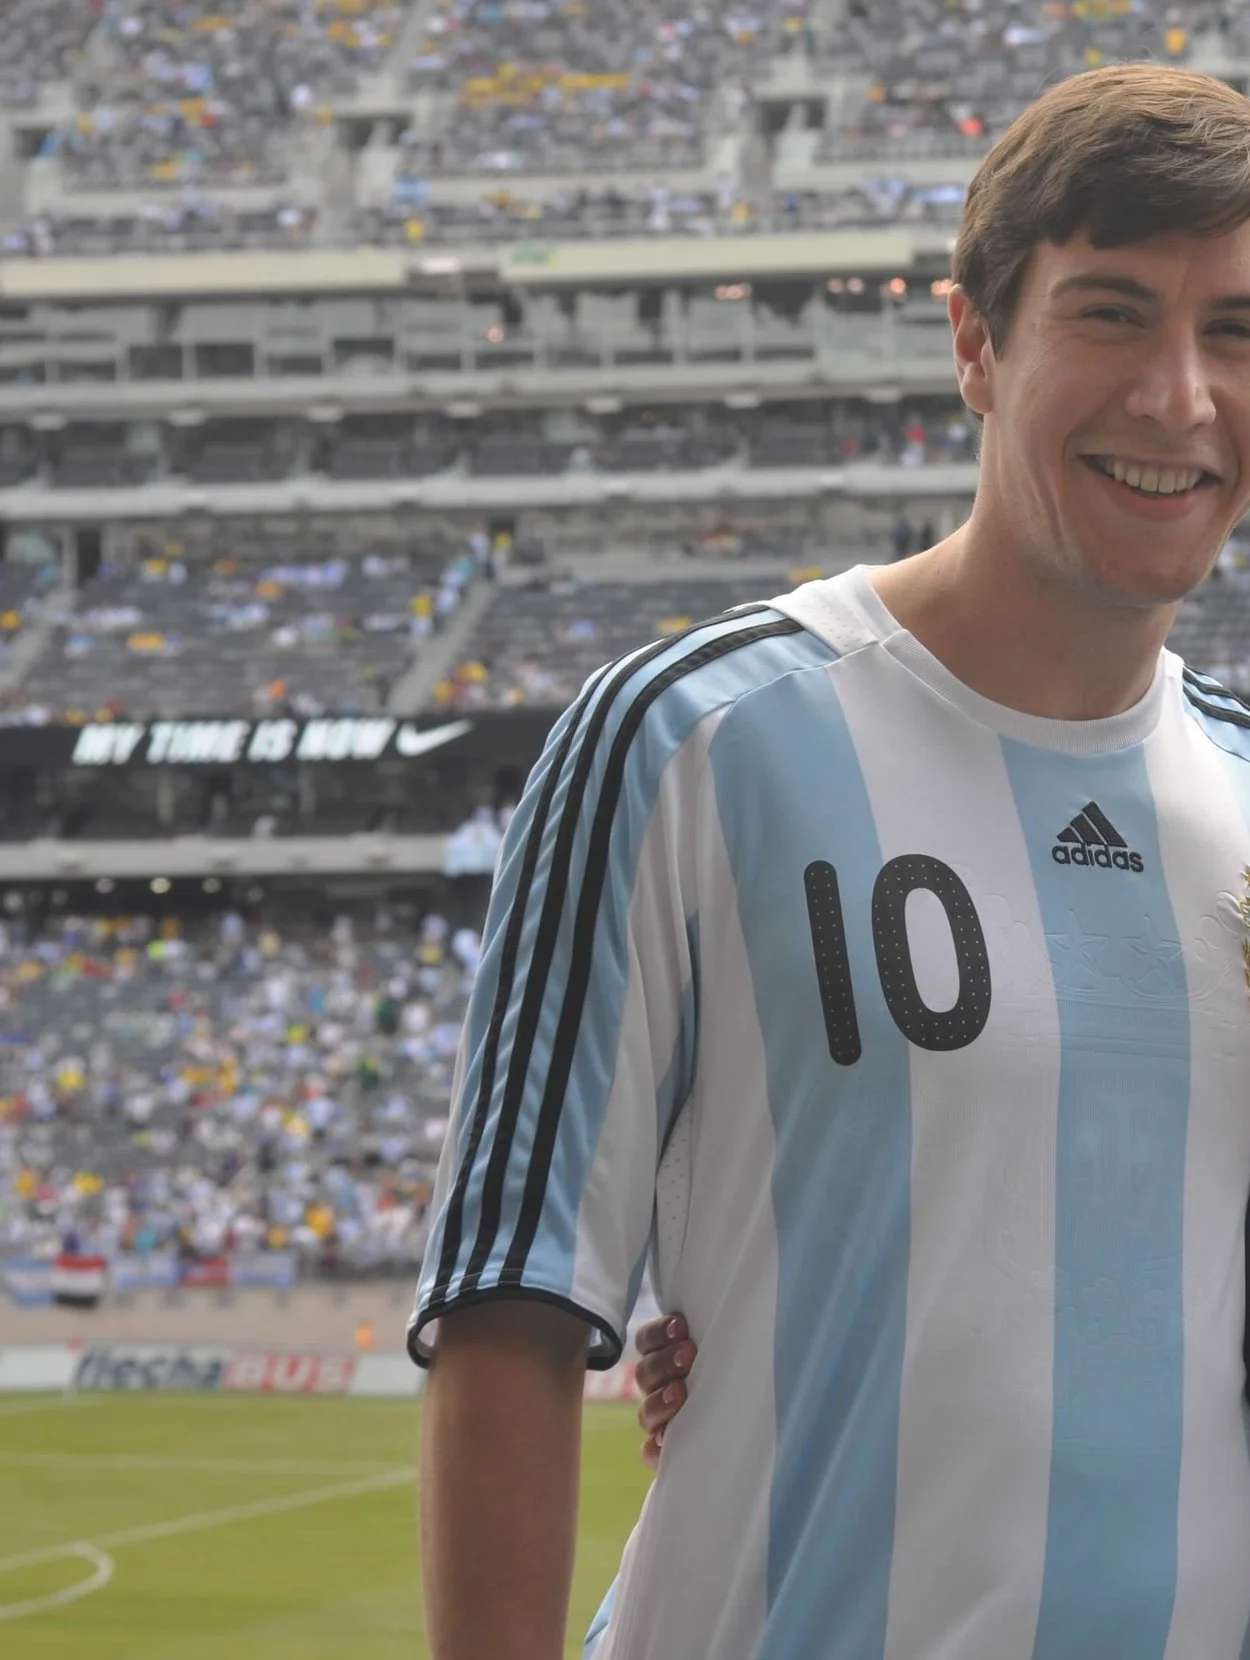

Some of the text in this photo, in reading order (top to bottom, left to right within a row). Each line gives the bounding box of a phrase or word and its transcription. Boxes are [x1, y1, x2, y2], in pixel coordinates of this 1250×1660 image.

[73, 716, 397, 765] MY TIME IS NOW
[1051, 841, 1145, 873] adidas
[804, 853, 992, 1067] 10
